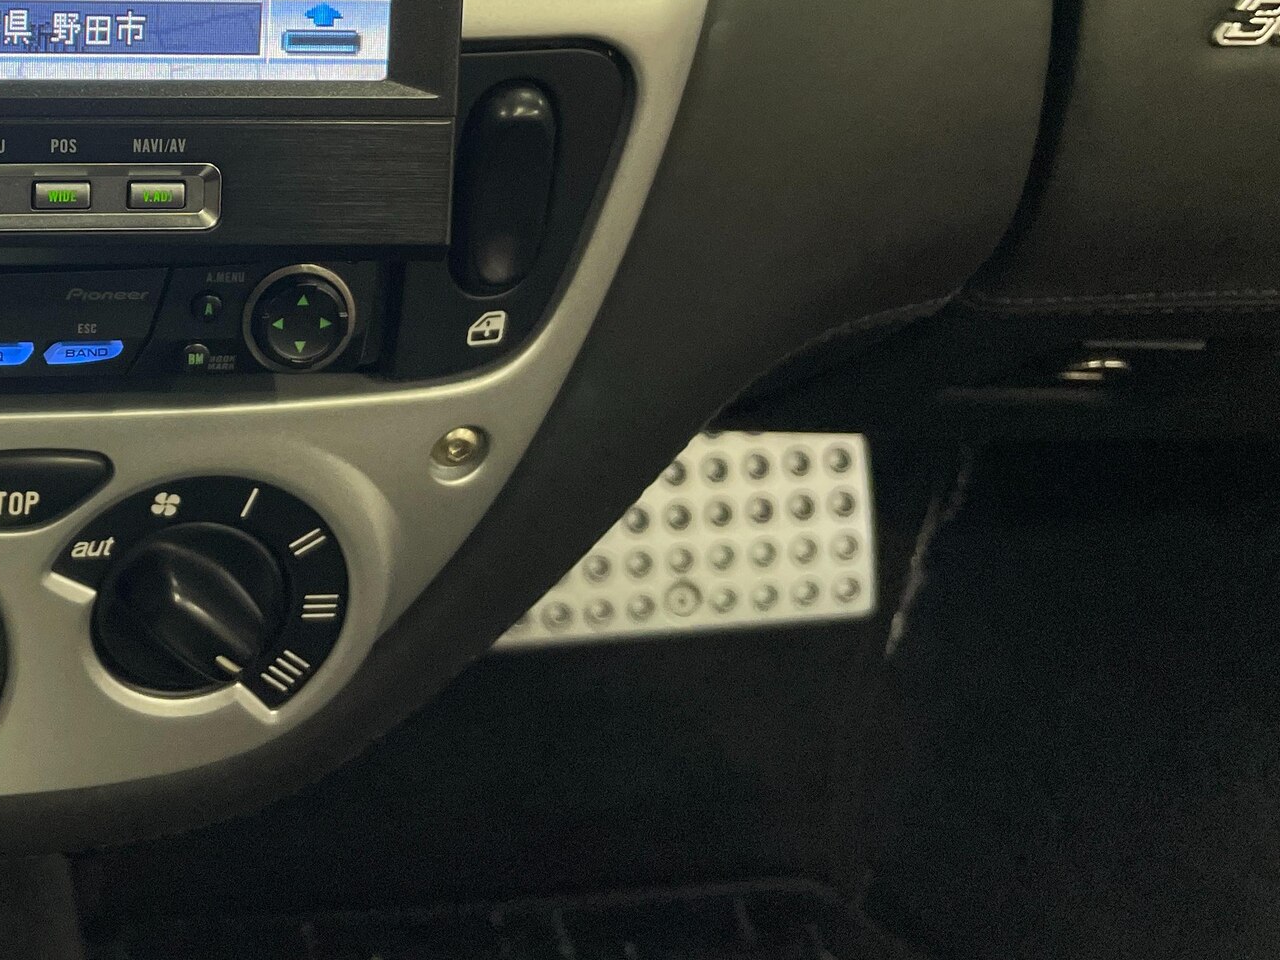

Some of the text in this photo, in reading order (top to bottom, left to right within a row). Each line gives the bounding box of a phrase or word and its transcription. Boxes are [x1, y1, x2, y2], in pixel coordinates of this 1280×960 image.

[50, 9, 147, 46] 野田市
[51, 139, 77, 153] POS
[133, 139, 187, 153] NAVI/AV
[47, 191, 77, 203] WIDE
[65, 287, 150, 302] Pioneer
[204, 302, 213, 316] A
[77, 323, 98, 334] ESC
[65, 348, 108, 358] BAND
[188, 352, 204, 365] BM
[71, 537, 114, 557] aut
